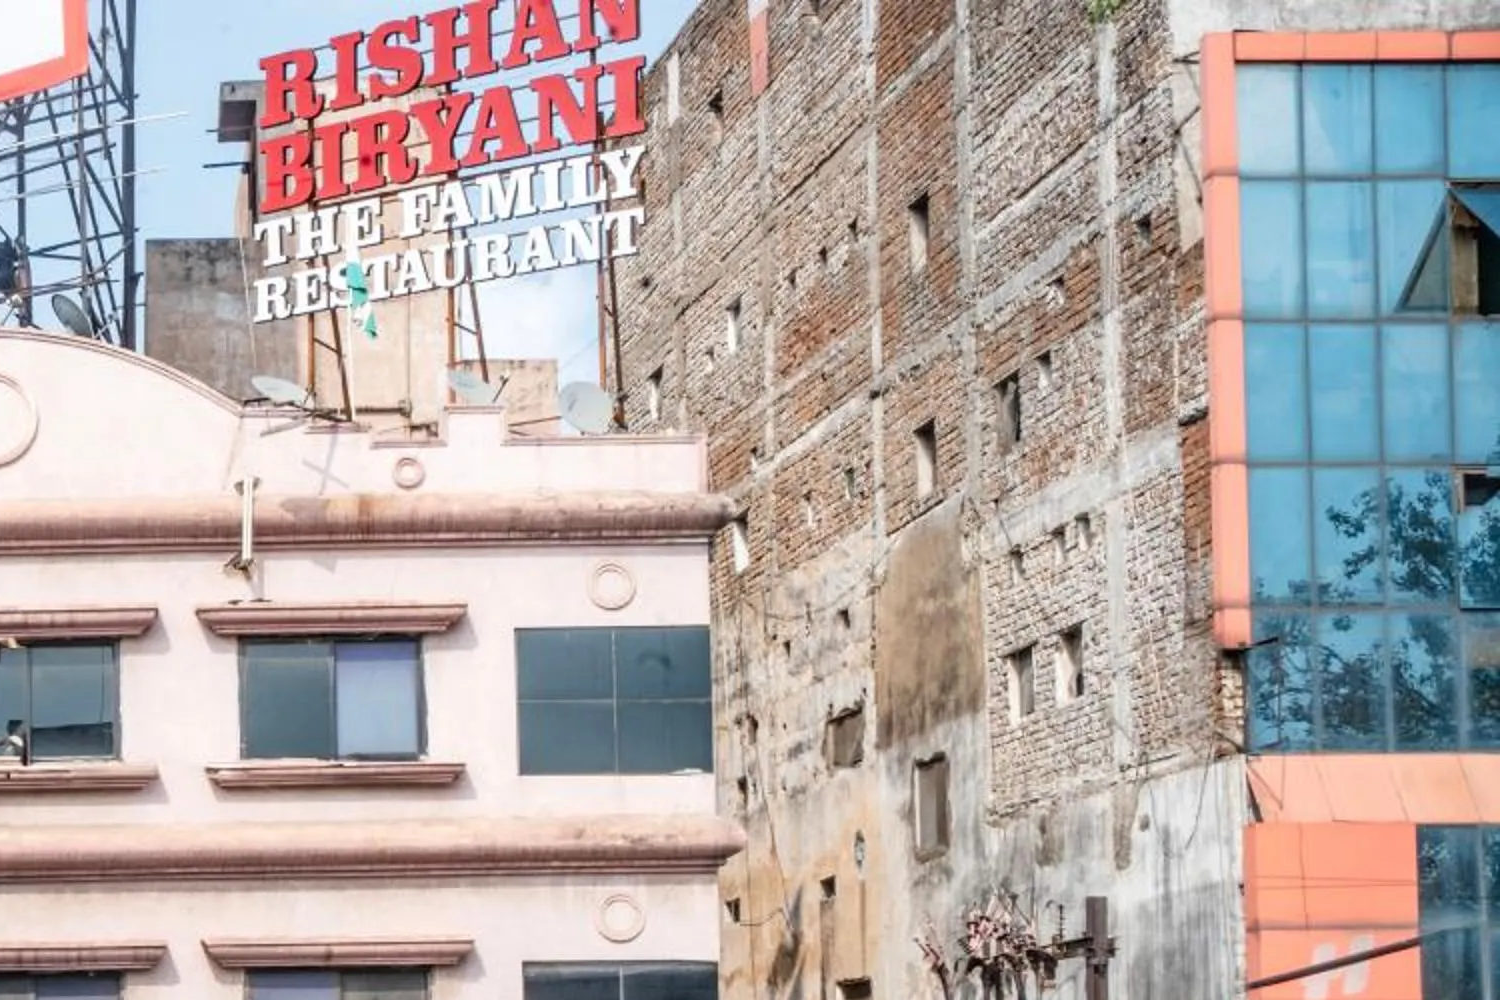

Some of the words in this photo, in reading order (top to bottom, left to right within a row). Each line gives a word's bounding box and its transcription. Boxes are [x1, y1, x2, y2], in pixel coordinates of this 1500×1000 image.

[259, 0, 642, 130] RISHAN
[259, 55, 647, 214] BIRYANI
[254, 195, 384, 268] THE
[400, 145, 647, 240] FAMILY
[254, 208, 646, 324] RESTAURANT
